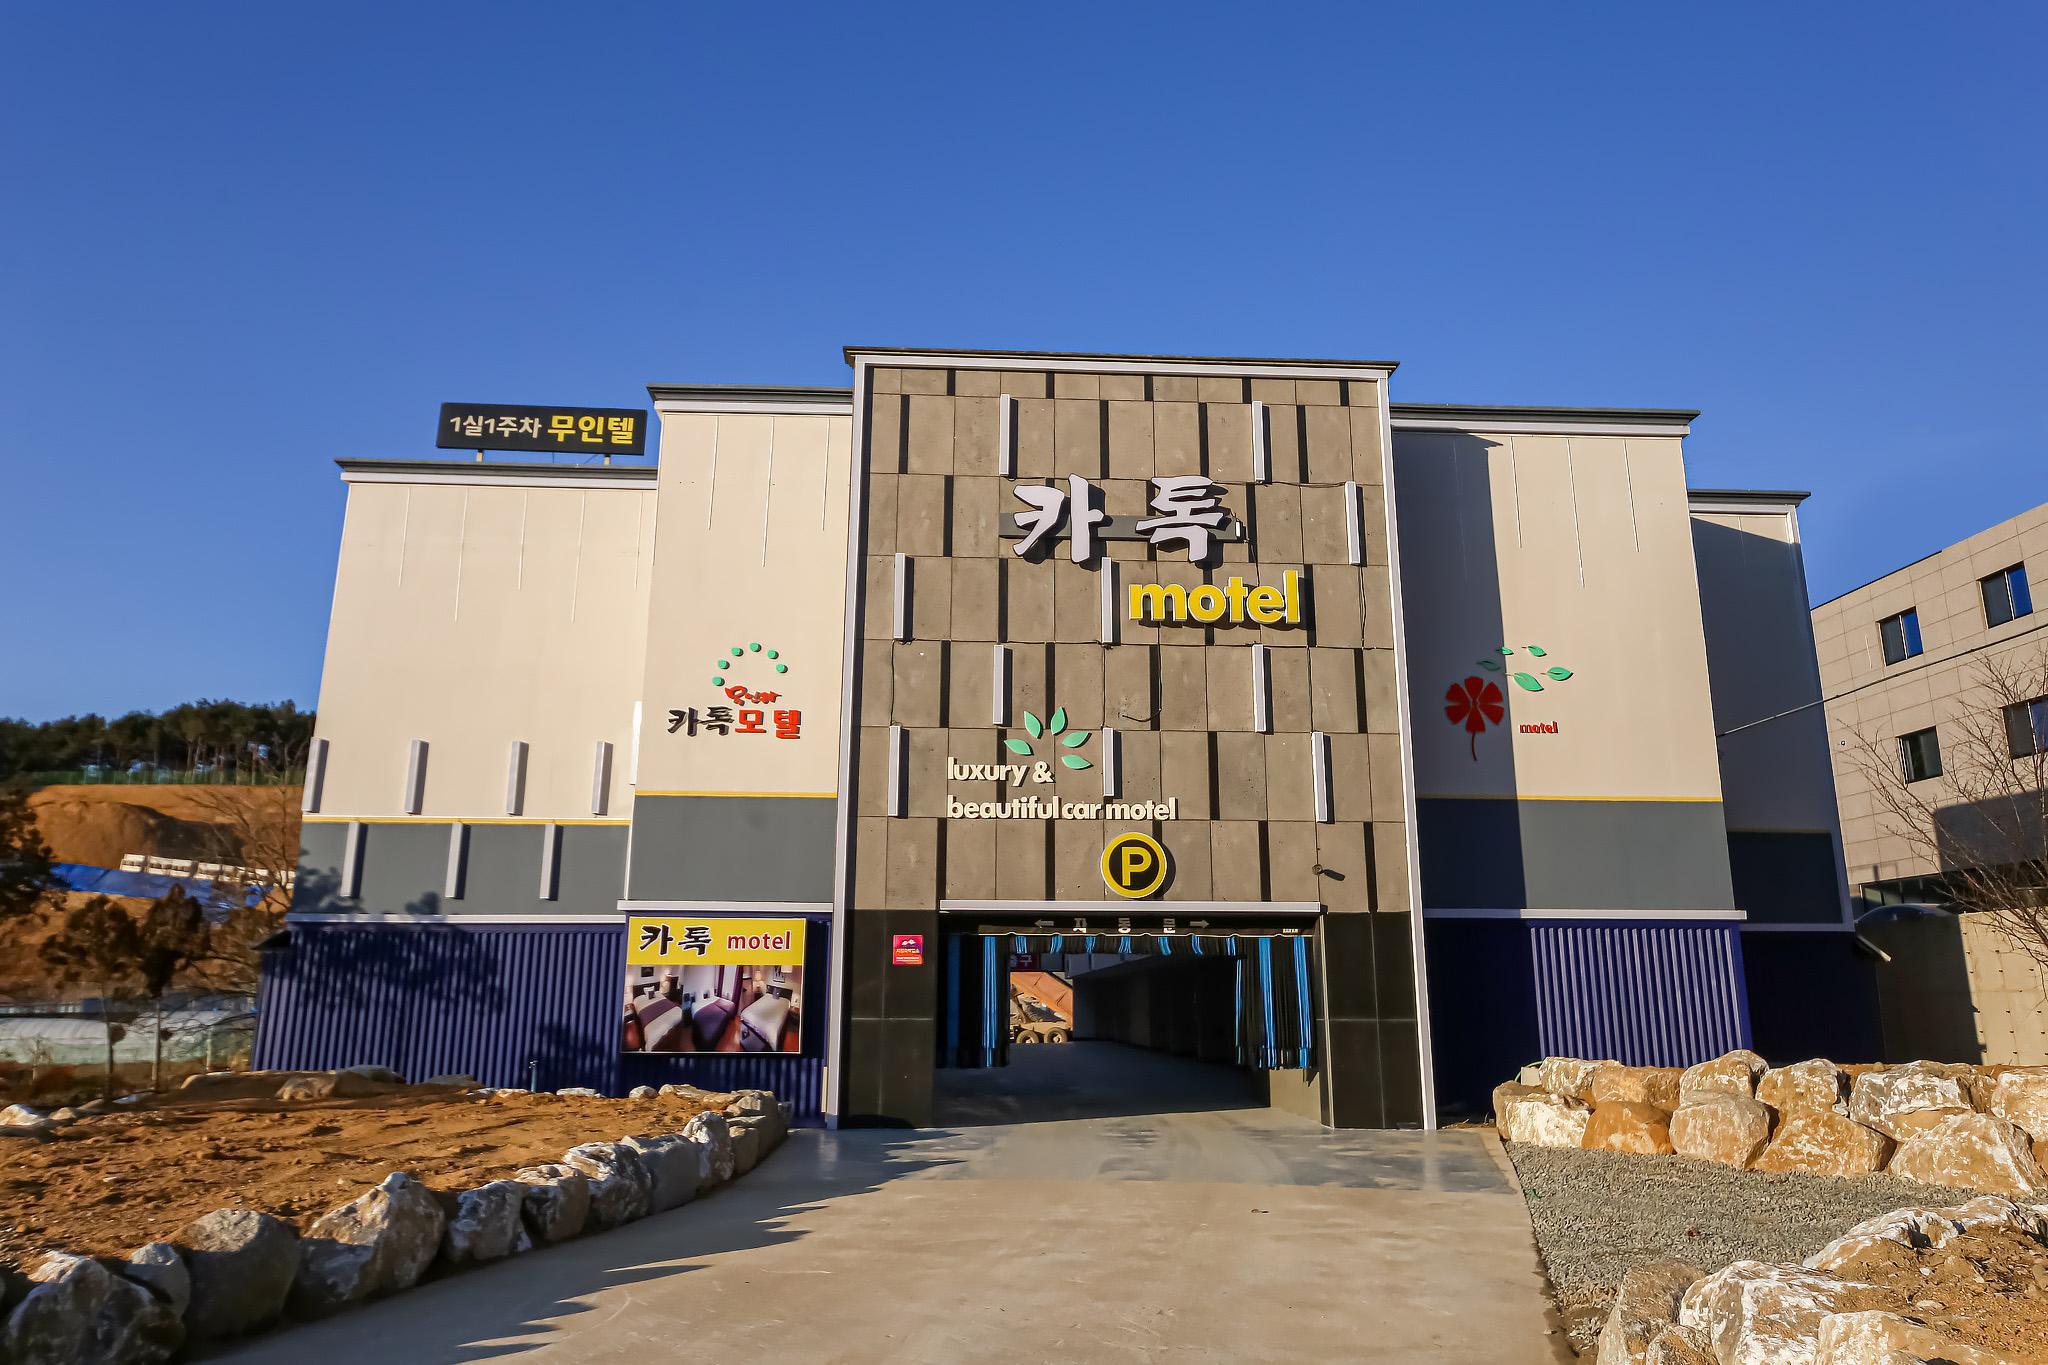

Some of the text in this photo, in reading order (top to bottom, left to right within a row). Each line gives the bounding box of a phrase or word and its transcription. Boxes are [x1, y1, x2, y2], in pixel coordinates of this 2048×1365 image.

[547, 415, 635, 445] 무인텔
[1012, 473, 1224, 564] 카톡
[1129, 570, 1300, 624] motel
[1519, 720, 1559, 734] motel
[947, 757, 1055, 787] luxury &
[947, 795, 1177, 821] beautiful car motel
[1121, 846, 1152, 887] P
[639, 923, 791, 956] 카톡 motel
